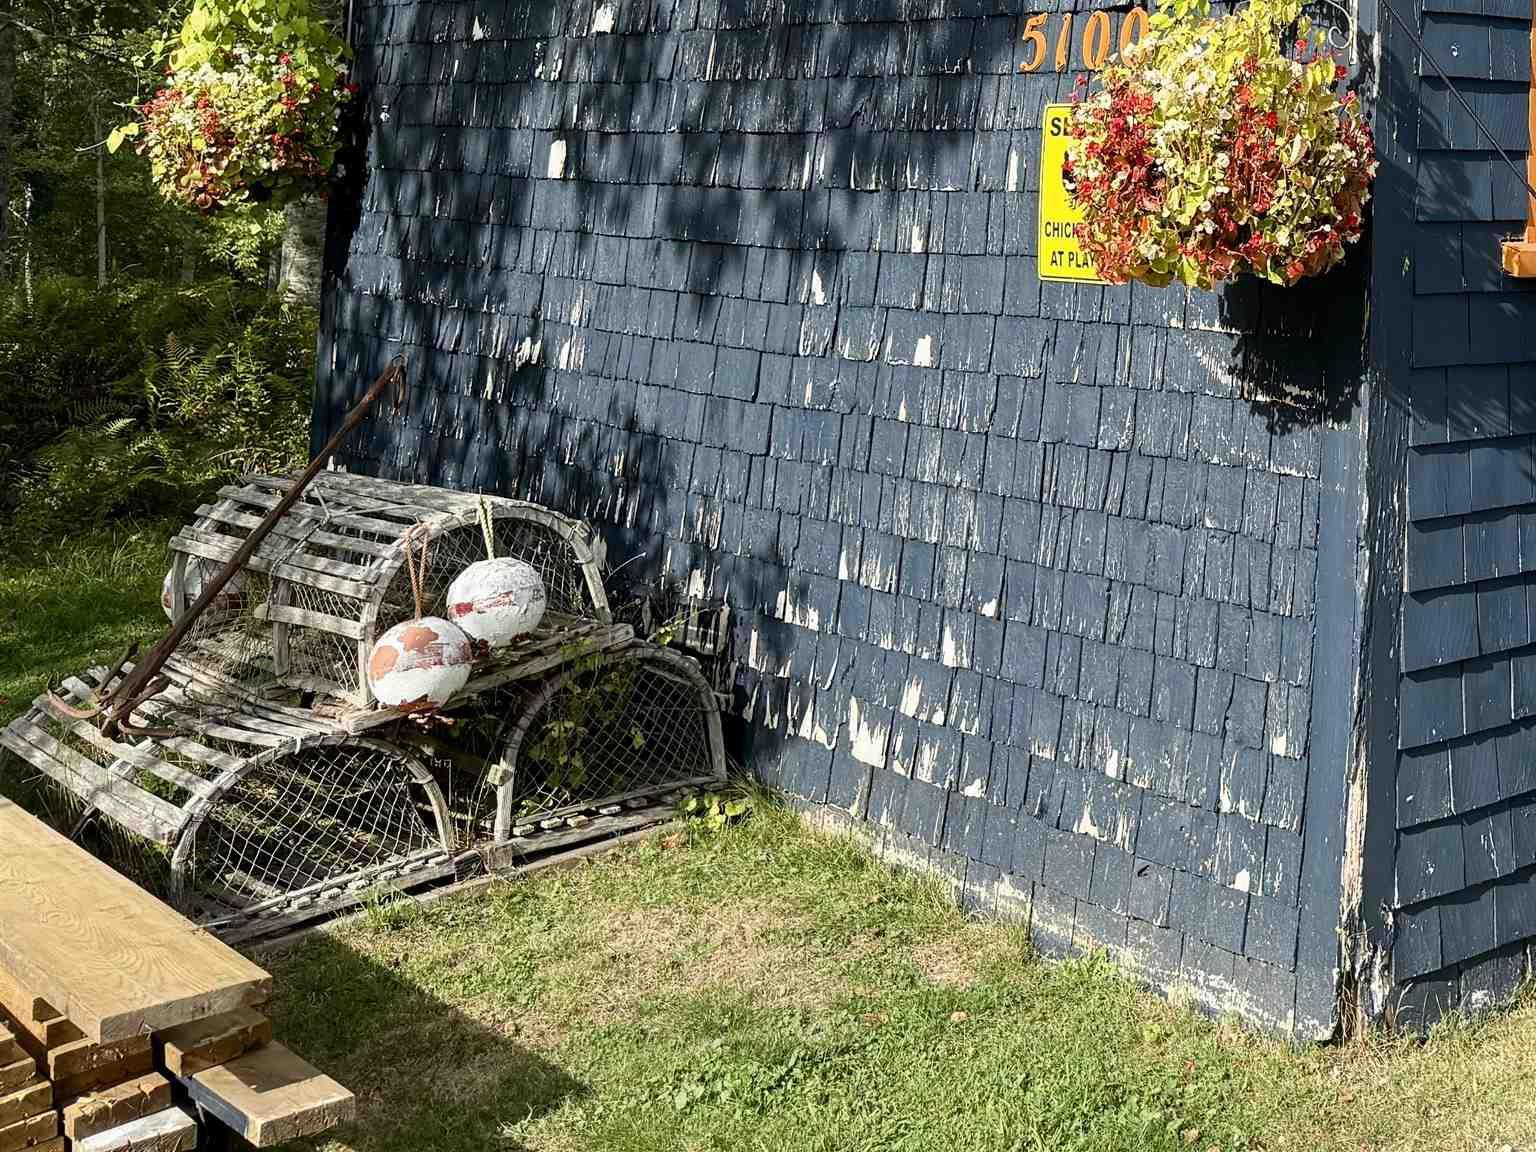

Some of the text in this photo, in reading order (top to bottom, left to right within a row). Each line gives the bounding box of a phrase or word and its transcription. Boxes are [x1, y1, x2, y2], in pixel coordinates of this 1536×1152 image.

[1020, 6, 1149, 72] 5100
[1050, 250, 1096, 268] AT PLAY
